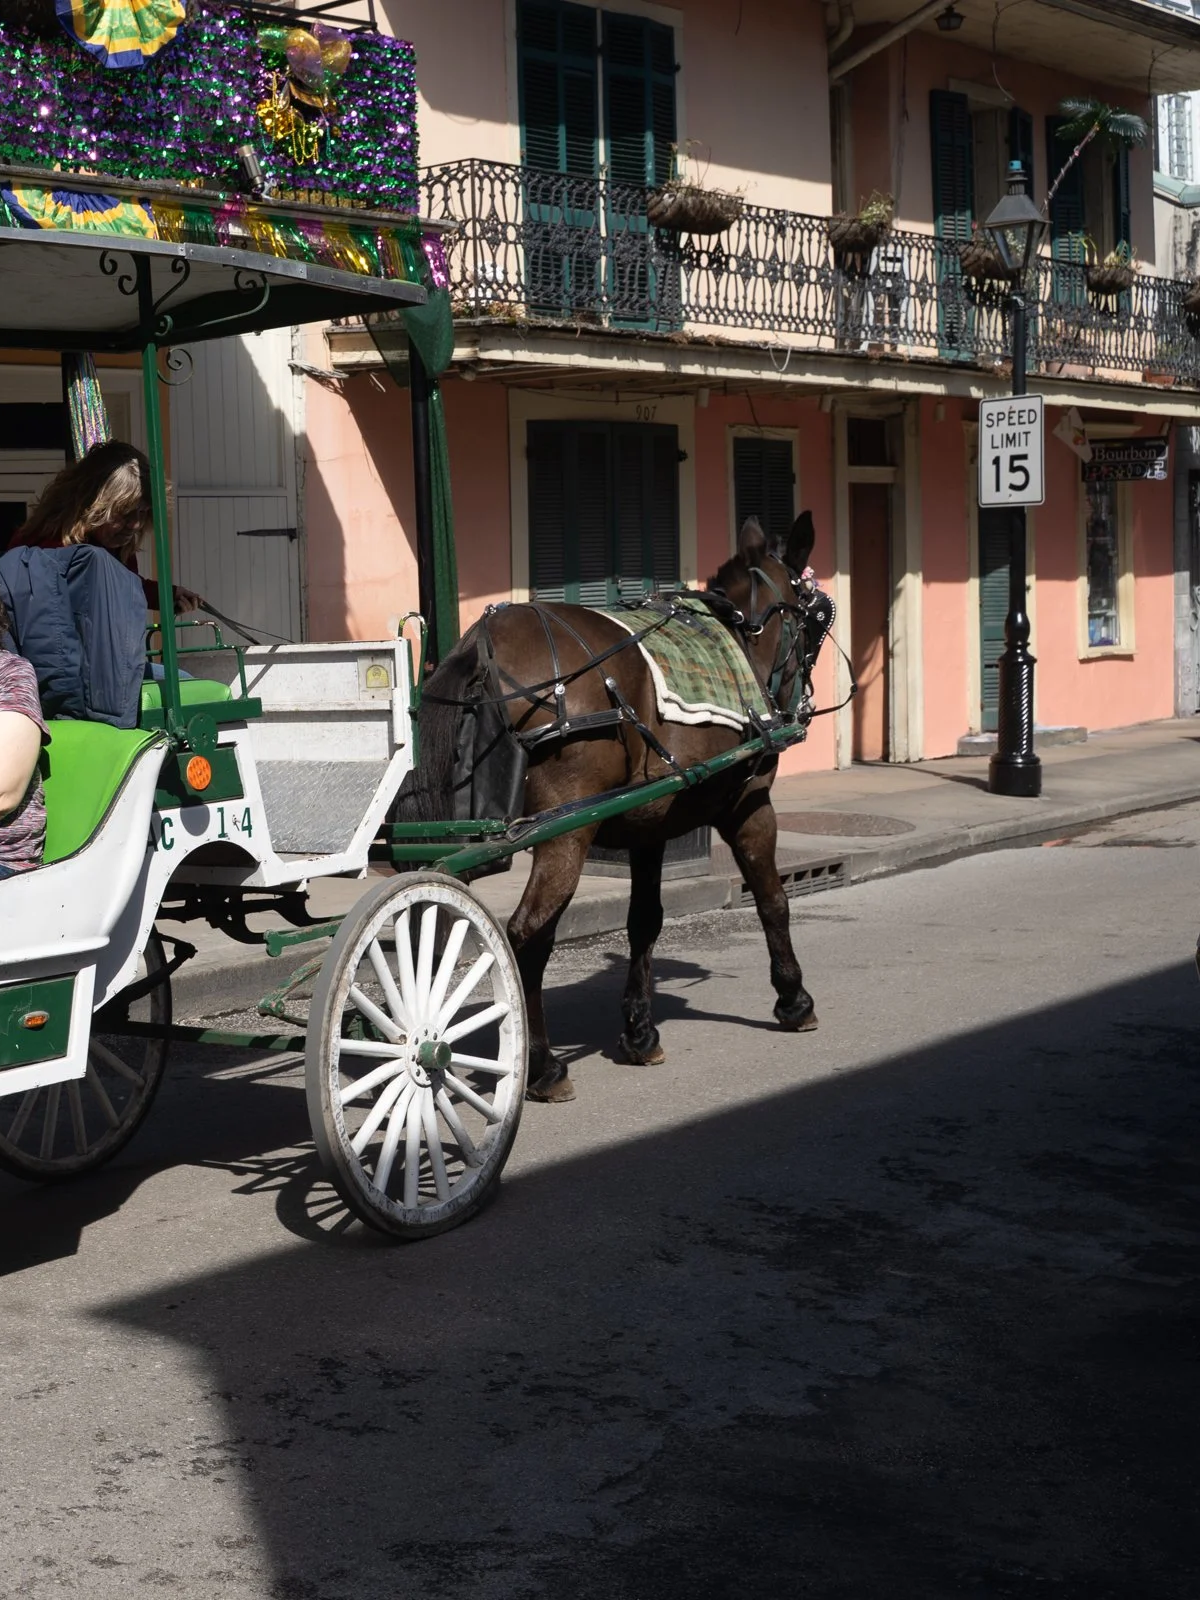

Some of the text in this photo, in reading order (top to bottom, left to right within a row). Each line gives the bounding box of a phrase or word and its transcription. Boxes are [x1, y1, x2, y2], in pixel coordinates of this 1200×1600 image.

[636, 405, 657, 421] 907
[986, 408, 1037, 428] SPEED
[991, 431, 1031, 449] LIMIT
[1095, 446, 1157, 460] Bourbon
[992, 454, 1030, 492] 15
[217, 806, 253, 839] 14
